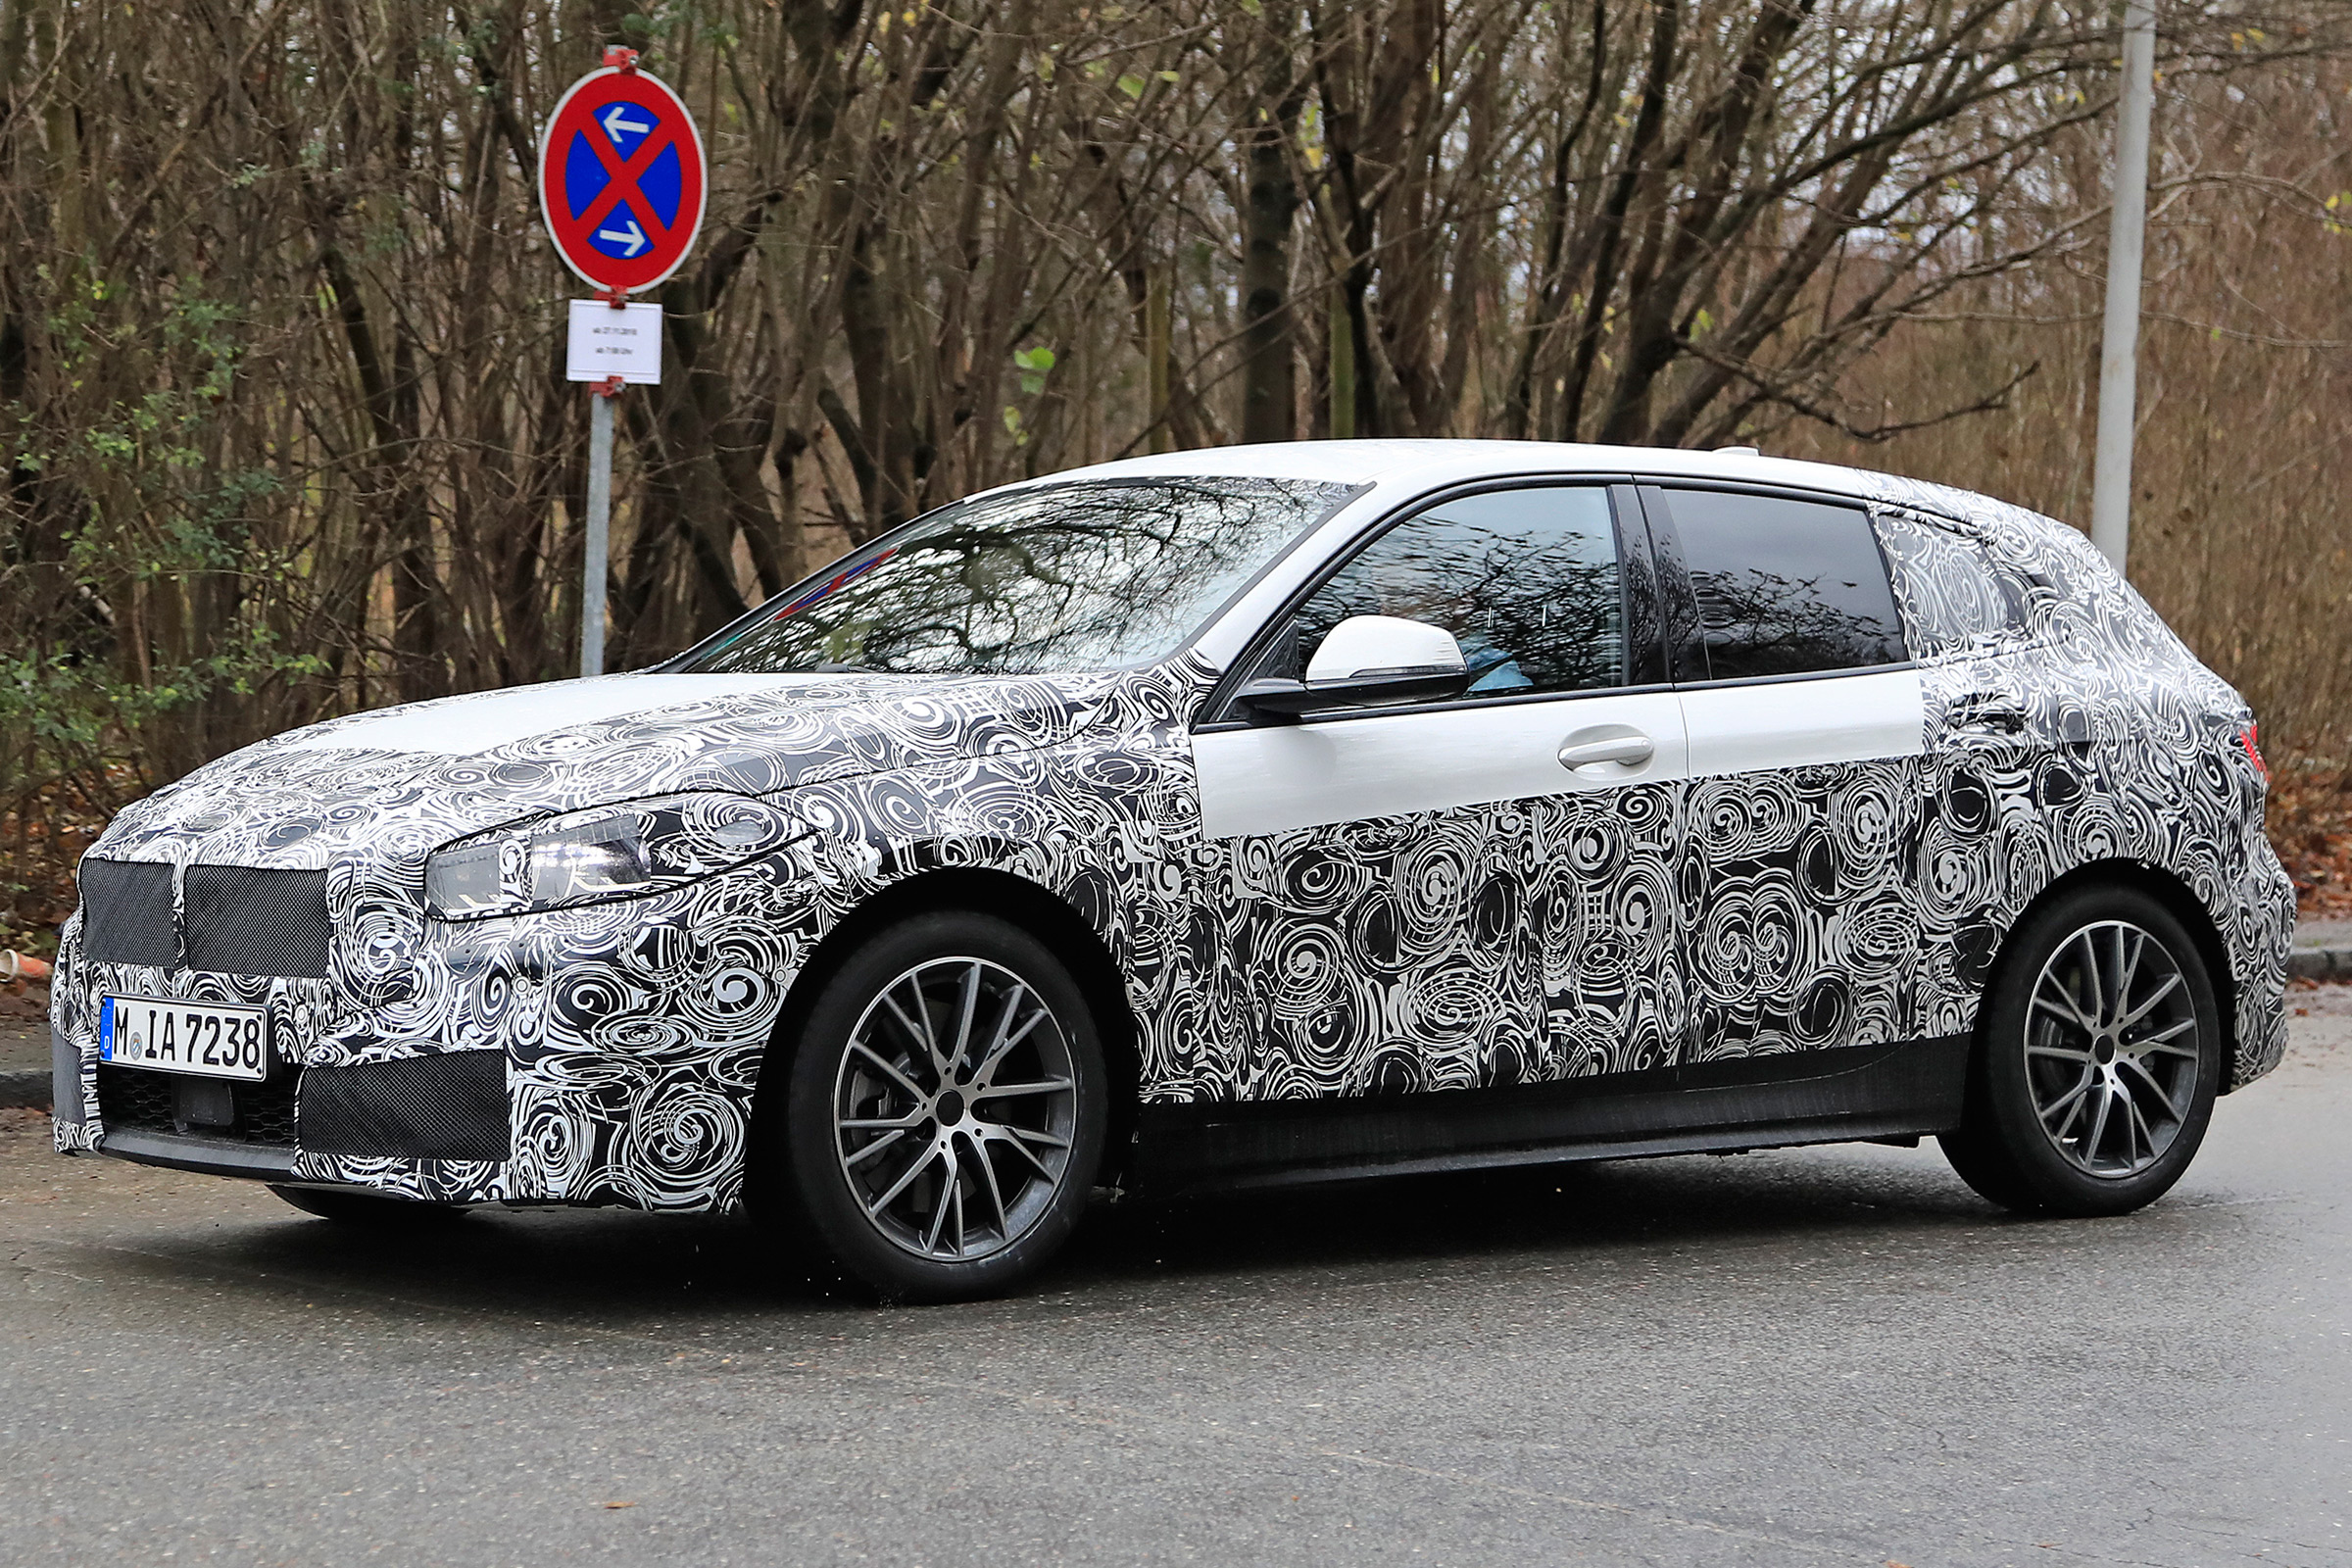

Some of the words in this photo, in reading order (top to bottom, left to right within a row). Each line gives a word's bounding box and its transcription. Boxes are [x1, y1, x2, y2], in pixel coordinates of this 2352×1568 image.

[104, 1035, 110, 1050] D
[114, 1005, 129, 1055] M
[145, 1009, 176, 1061] IA
[185, 1013, 261, 1069] 7238
